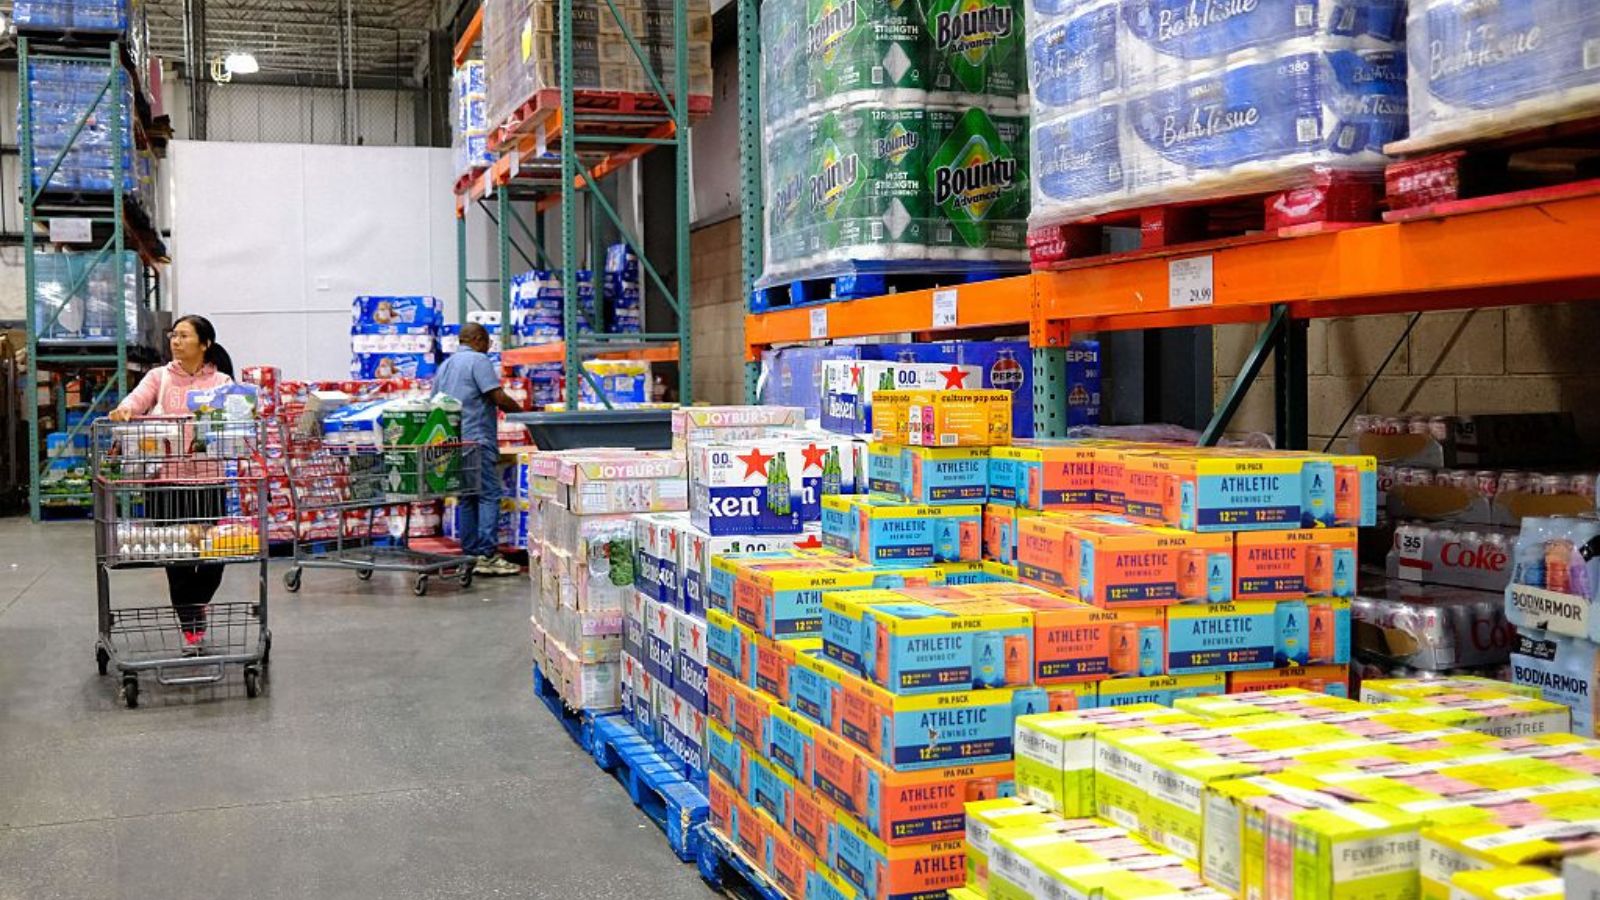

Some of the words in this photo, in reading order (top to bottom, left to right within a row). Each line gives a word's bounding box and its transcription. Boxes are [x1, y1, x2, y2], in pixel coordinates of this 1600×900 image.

[808, 0, 857, 60] Bounty
[936, 4, 1013, 50] Bounty
[1289, 62, 1310, 77] 380
[874, 131, 919, 159] Bounty
[809, 154, 858, 214] Bounty
[875, 181, 920, 190] STRENGTH
[936, 157, 1017, 205] Bounty
[954, 189, 1000, 209] Advanced
[993, 371, 1022, 381] PEPSI
[941, 394, 973, 404] culture
[974, 396, 989, 406] pop
[990, 395, 1009, 403] soda
[704, 411, 775, 427] JOYBURST
[599, 464, 671, 480] JOYBURST
[936, 460, 980, 475] ATHLETIC
[1236, 462, 1247, 471] IPA
[1247, 462, 1264, 471] PACK
[1221, 476, 1280, 493] ATHLETIC
[926, 508, 941, 516] PACK
[1220, 511, 1231, 522] 12
[1256, 510, 1267, 521] 12
[882, 520, 926, 536] ATHLETIC
[1157, 538, 1168, 547] IPA
[1169, 537, 1186, 547] PACK
[1286, 533, 1297, 541] IPA
[1298, 532, 1313, 541] PACK
[1403, 536, 1421, 549] 35
[1247, 547, 1296, 562] ATHLETIC
[1440, 542, 1506, 572] Coke
[1116, 553, 1168, 569] ATHLETIC
[1243, 581, 1252, 592] 12
[1274, 579, 1283, 590] 12
[1111, 588, 1121, 599] 12
[1145, 587, 1154, 598] 12
[1208, 604, 1219, 613] IPA
[1220, 602, 1236, 612] PACK
[1512, 591, 1583, 621] BODYARMOR
[1089, 612, 1100, 621] IPA
[1101, 610, 1118, 620] PACK
[951, 620, 964, 630] IPA
[965, 619, 982, 629] PACK
[1192, 617, 1253, 635] ATHLETIC
[1047, 627, 1100, 644] ATHLETIC
[906, 636, 962, 654] ATHLETIC
[1191, 653, 1201, 665] 12
[1228, 651, 1238, 663] 12
[1043, 664, 1053, 676] 12
[1076, 661, 1087, 673] 12
[902, 674, 912, 686] 12
[938, 671, 950, 683] 12
[1149, 678, 1160, 687] IPA
[1160, 677, 1177, 686] PACK
[1515, 666, 1589, 697] BODYARMOR
[938, 695, 951, 704] IPA
[951, 694, 969, 703] PACK
[1109, 693, 1159, 708] ATHLETIC
[920, 708, 987, 728] ATHLETIC
[1019, 731, 1059, 756] FEVER-TREE
[920, 748, 932, 760] 12
[961, 744, 972, 756] 12
[1099, 748, 1143, 775] FEVER-TREE
[943, 767, 955, 778] IPA
[955, 766, 974, 776] PACK
[900, 784, 956, 803] ATHLETIC
[895, 824, 906, 836] 12
[932, 820, 943, 831] 12
[931, 843, 943, 852] IPA
[944, 840, 962, 850] PACK
[1342, 842, 1420, 863] FEVER-TREE
